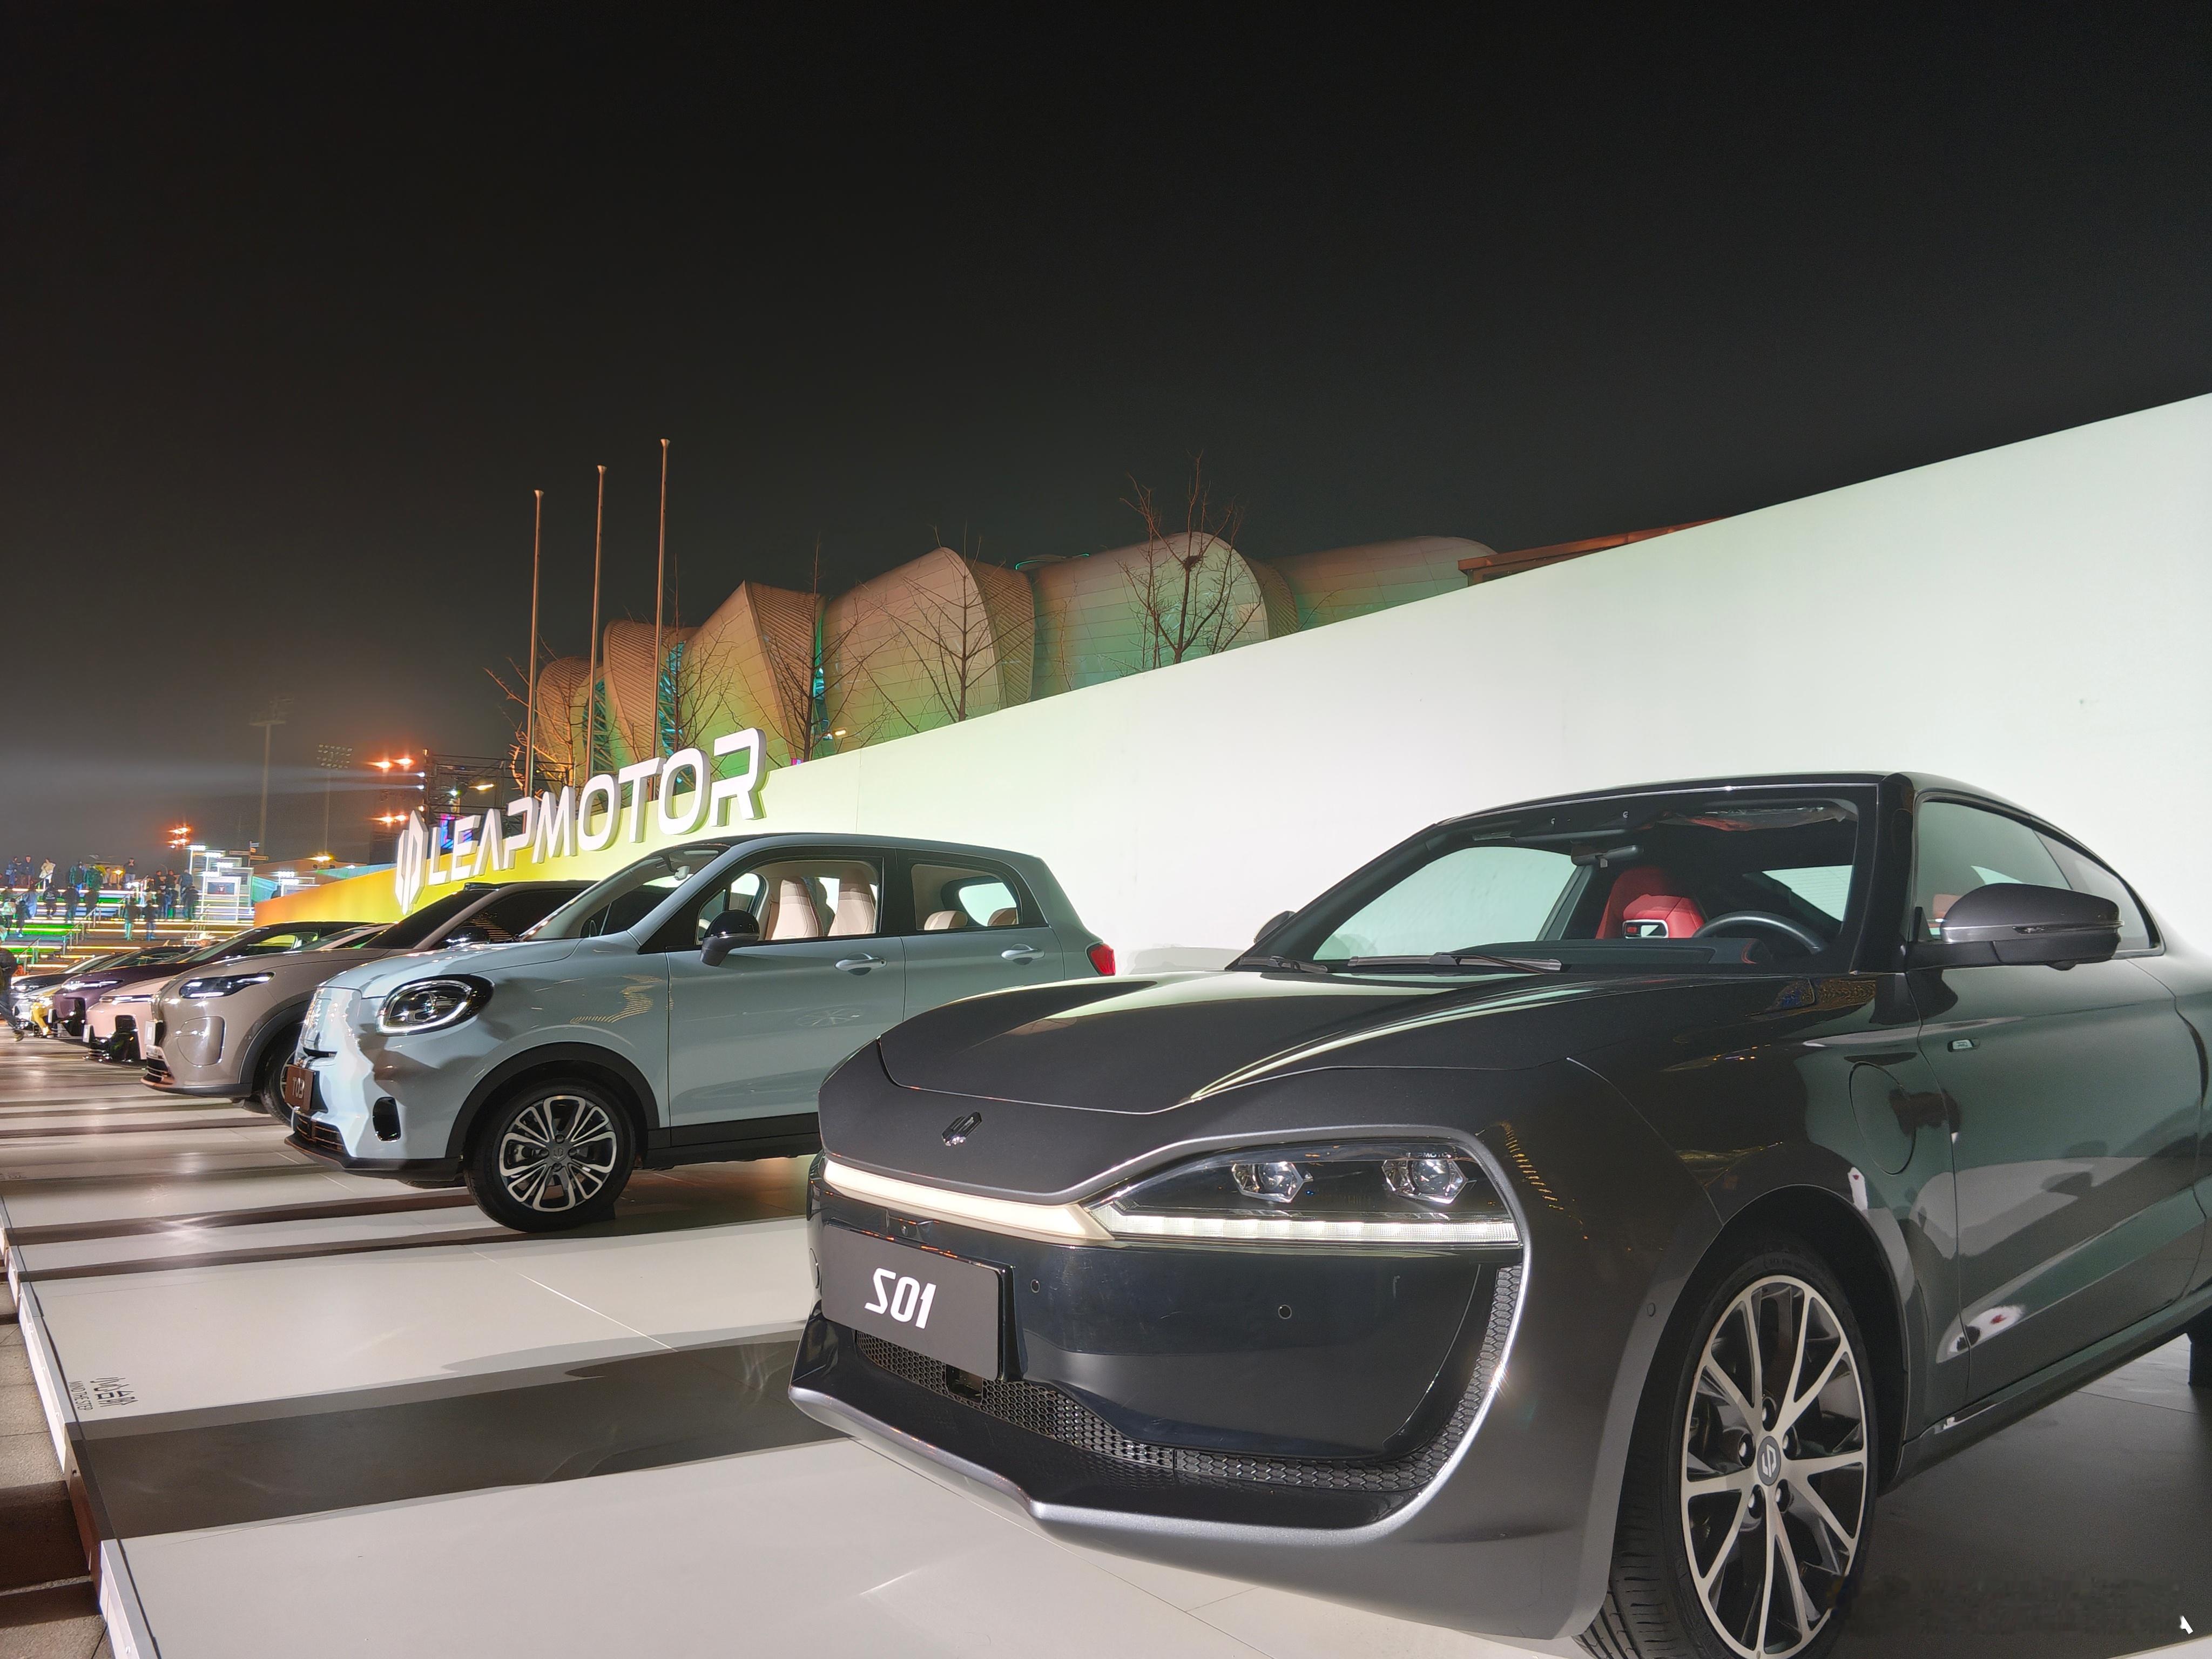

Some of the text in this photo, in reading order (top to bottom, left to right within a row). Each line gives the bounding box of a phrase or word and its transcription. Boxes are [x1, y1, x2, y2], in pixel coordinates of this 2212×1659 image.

[428, 727, 766, 887] LEAPMOTOR
[865, 1267, 936, 1329] S01
[69, 1380, 93, 1411] MIND THE STEP
[90, 1377, 139, 1408] 小心台阶
